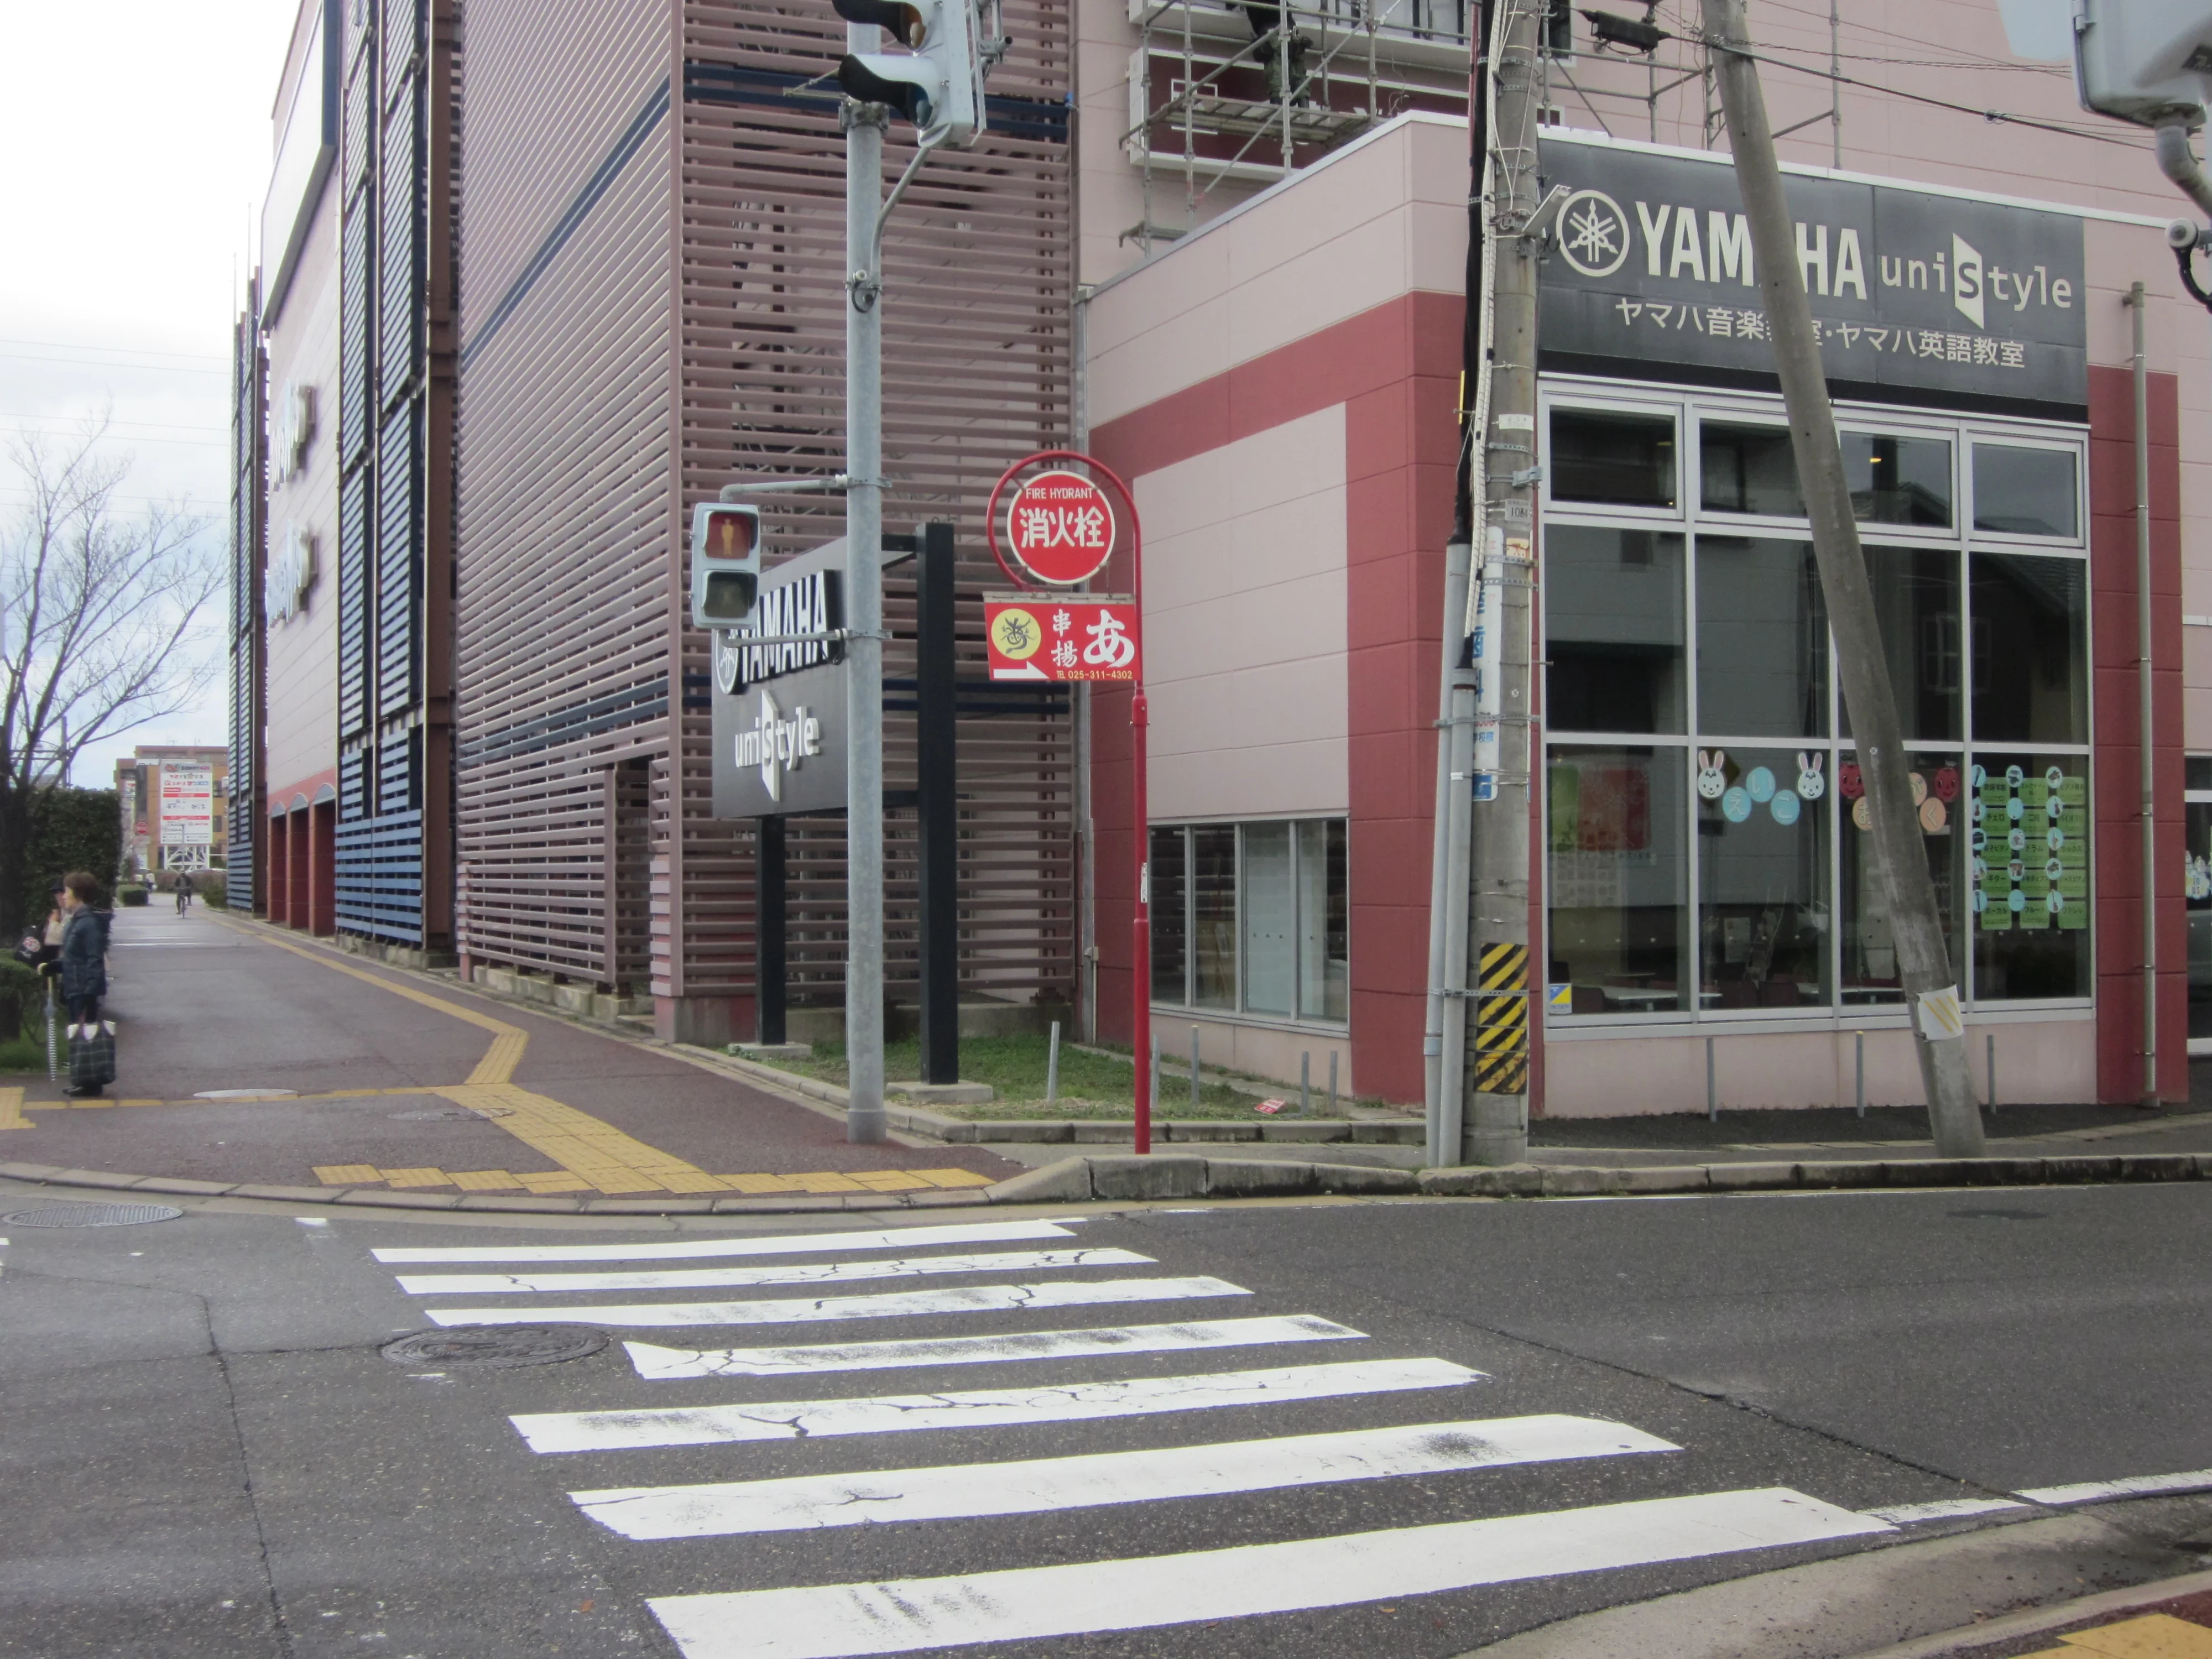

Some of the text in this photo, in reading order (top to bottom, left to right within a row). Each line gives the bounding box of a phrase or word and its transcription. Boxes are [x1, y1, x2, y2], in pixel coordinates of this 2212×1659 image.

[1636, 200, 1867, 300] YAMHA
[1615, 297, 2025, 369] ヤマハ音楽・ヤマハ英語教室
[1026, 487, 1093, 499] FIRE HYDRANT
[1019, 506, 1105, 548] 消火栓
[1083, 609, 1135, 669] あ
[1068, 670, 1133, 680] 025-311-4302
